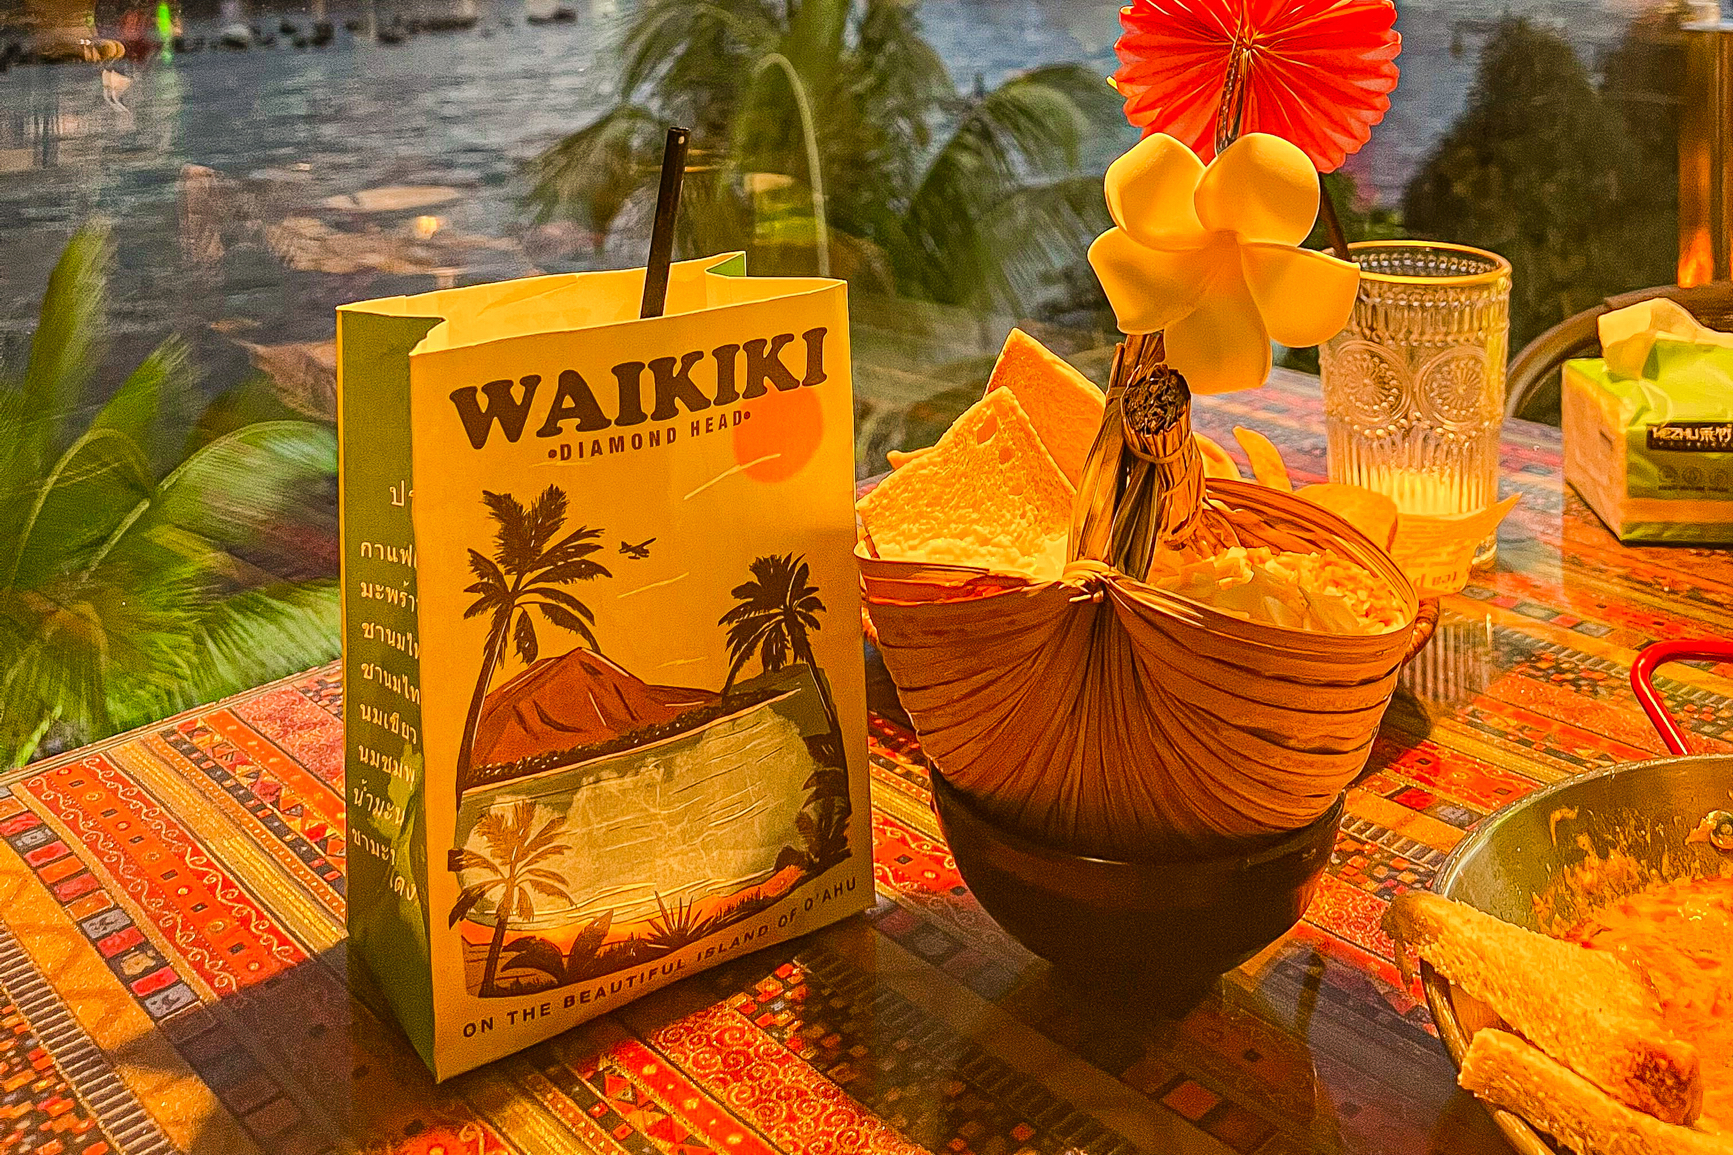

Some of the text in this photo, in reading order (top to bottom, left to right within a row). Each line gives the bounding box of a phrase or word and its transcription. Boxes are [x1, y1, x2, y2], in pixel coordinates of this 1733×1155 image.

[450, 327, 828, 450] WAIKIKI
[560, 410, 742, 461] DIAMOND HEAD
[360, 580, 418, 613] มะพร้า
[463, 876, 856, 1038] ON THE BEAUTIFUL ISLAND OF O'AHU
